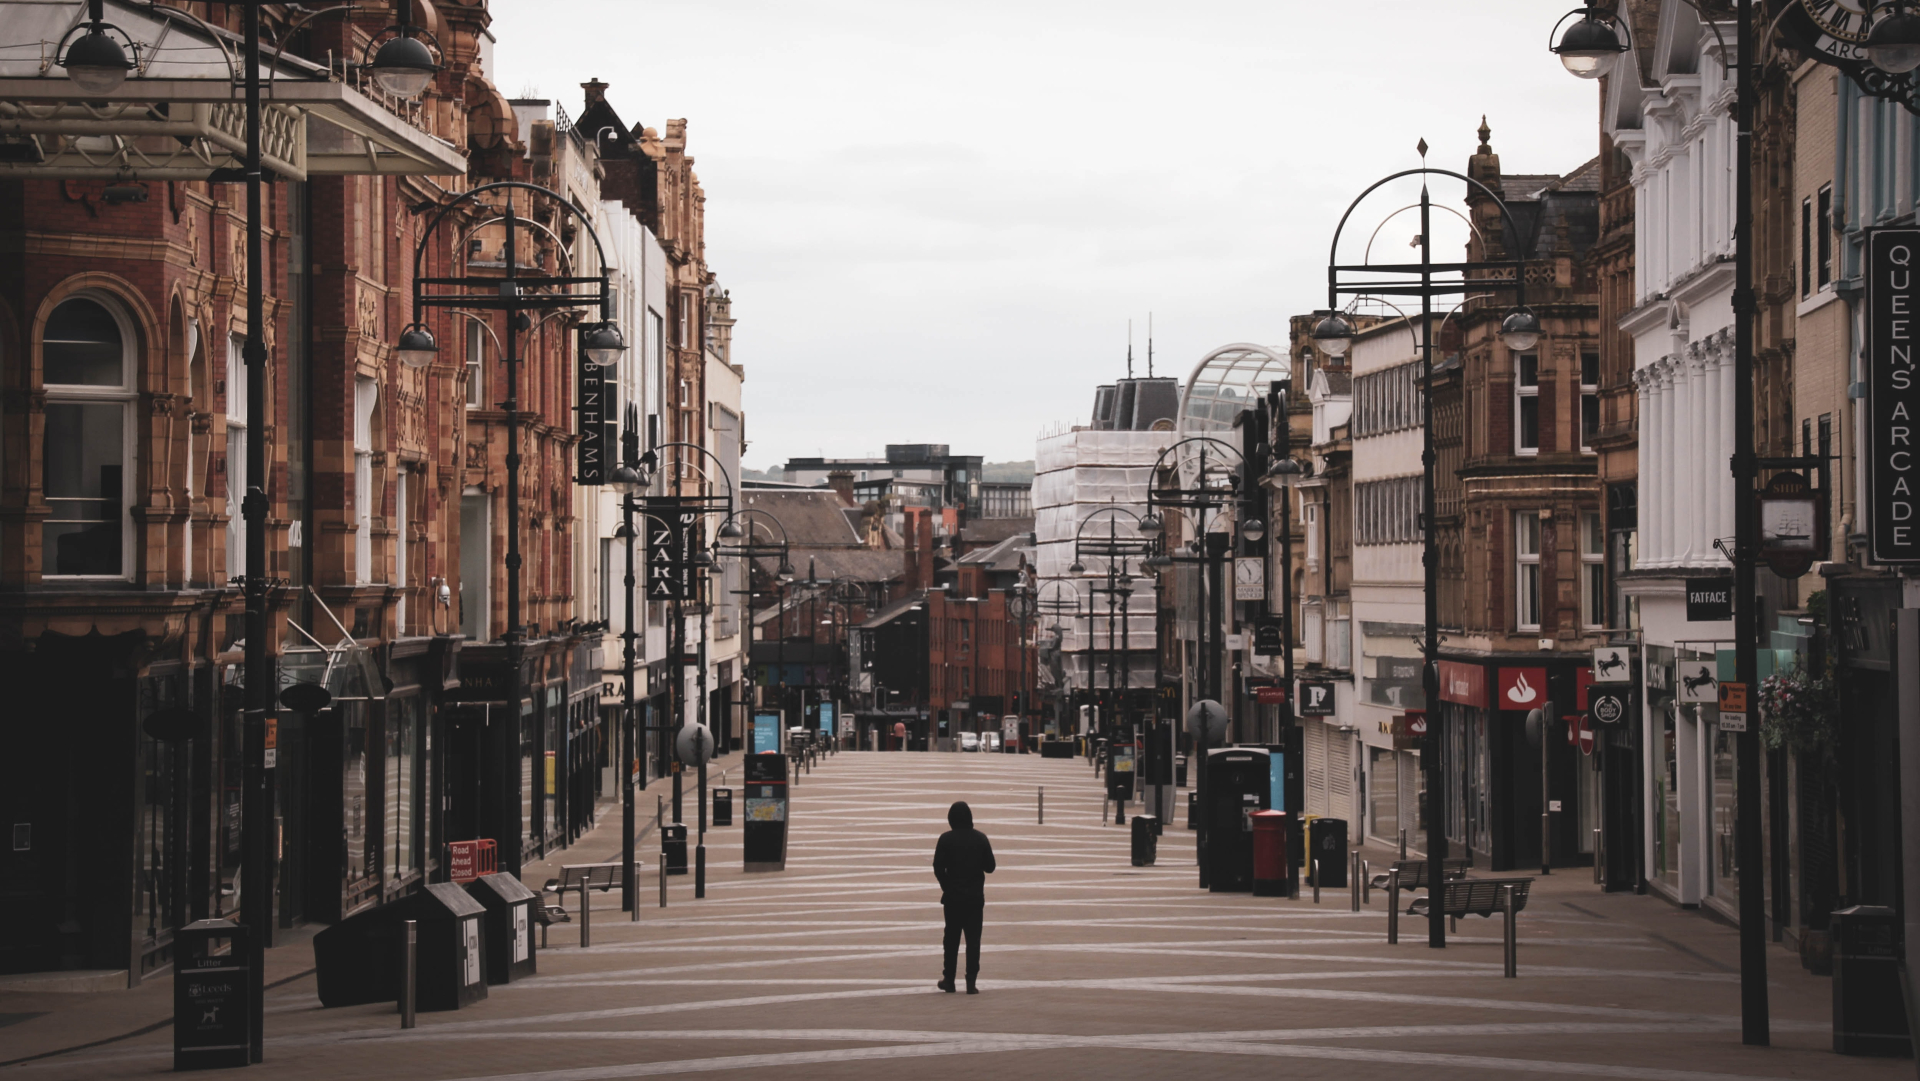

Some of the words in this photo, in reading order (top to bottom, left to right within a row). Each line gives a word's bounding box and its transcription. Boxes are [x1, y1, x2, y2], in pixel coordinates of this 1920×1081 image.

[1826, 41, 1864, 60] ARC
[1889, 244, 1916, 391] QUEEN'S
[584, 330, 599, 479] BENHAMS
[1889, 400, 1913, 547] ARCADE
[1773, 483, 1803, 494] SHIP
[651, 530, 673, 595] ZARA
[1690, 591, 1727, 604] FATFACE
[452, 845, 469, 855] Road
[451, 857, 472, 866] Ahead
[451, 868, 472, 877] Closed
[1868, 946, 1893, 955] Litter
[197, 959, 222, 968] Litter
[202, 983, 232, 993] Leeds
